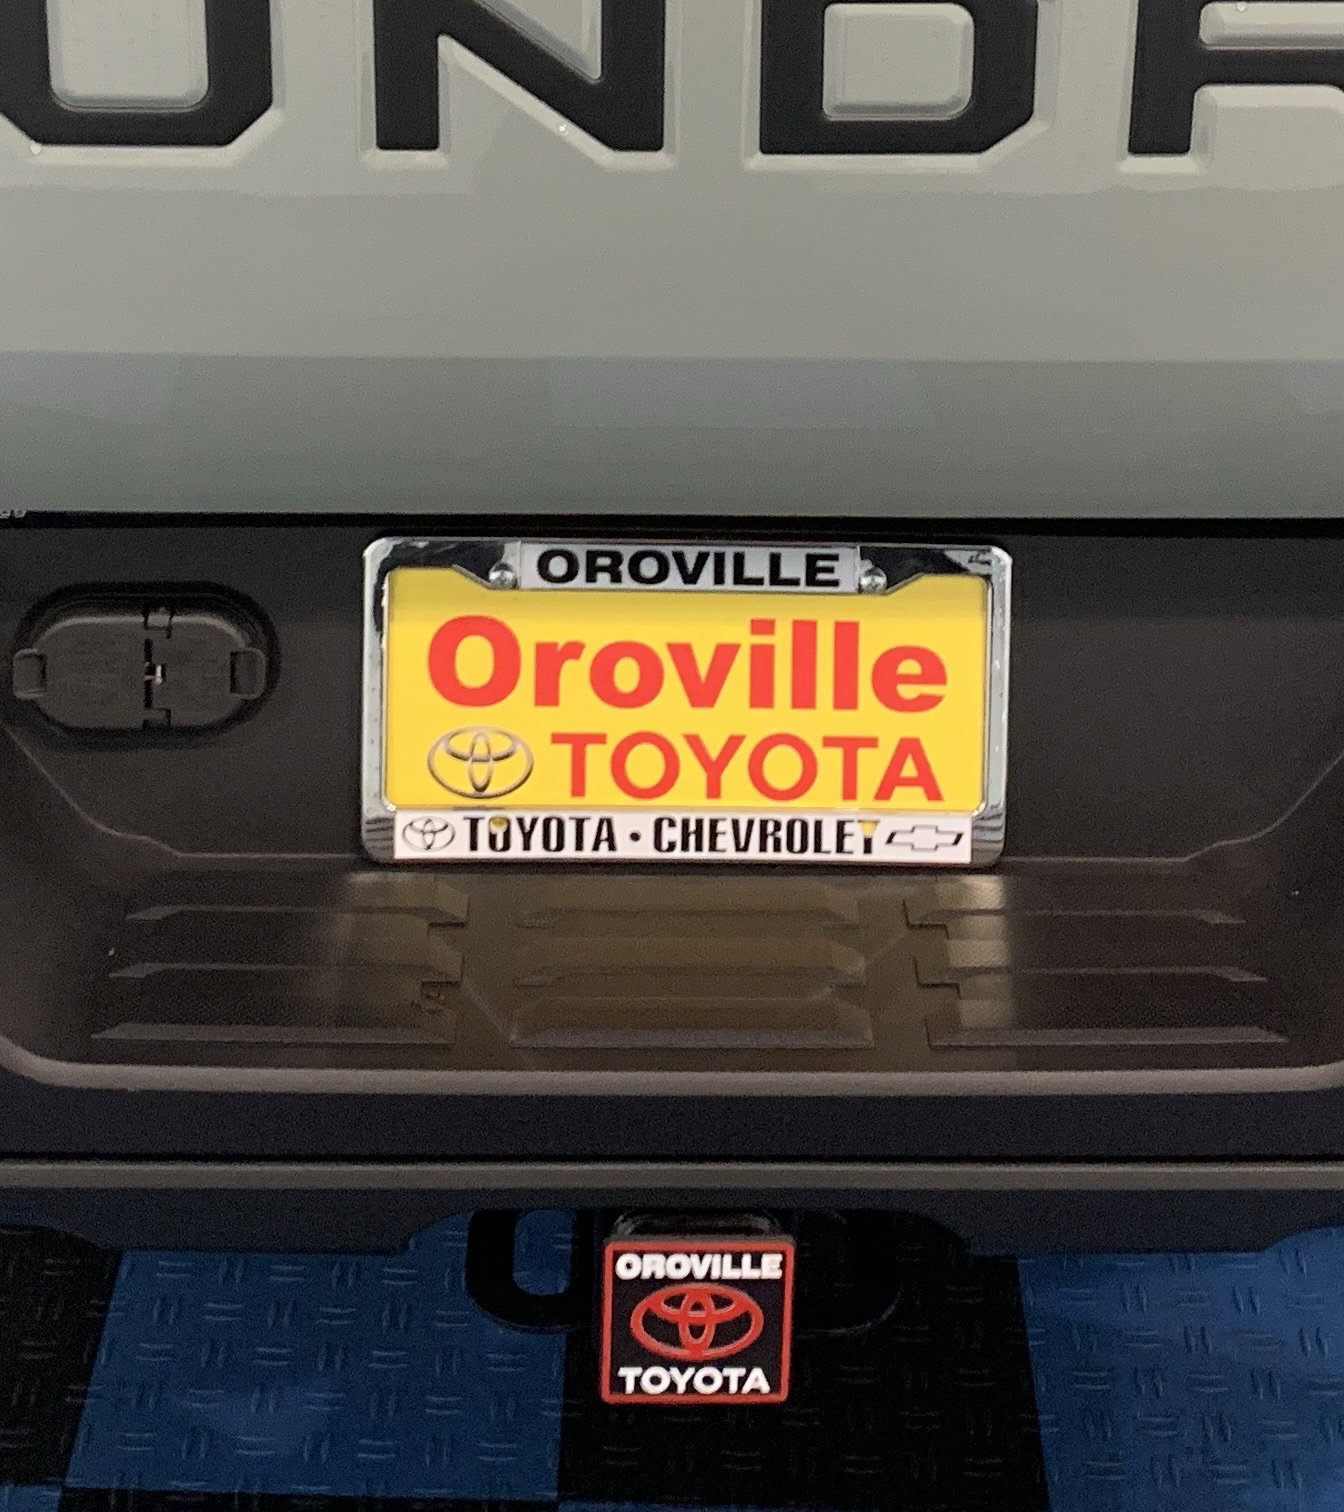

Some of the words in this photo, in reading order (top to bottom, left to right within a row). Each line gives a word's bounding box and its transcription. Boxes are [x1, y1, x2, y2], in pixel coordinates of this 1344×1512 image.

[536, 547, 841, 588] OROVILLE
[426, 614, 948, 714] Oroville
[550, 730, 945, 803] TOYOTA
[462, 815, 617, 854] TOYOTA
[653, 816, 880, 856] CHEVROLET
[615, 1252, 783, 1281] OROVILLE
[617, 1366, 771, 1395] TOYOTA
